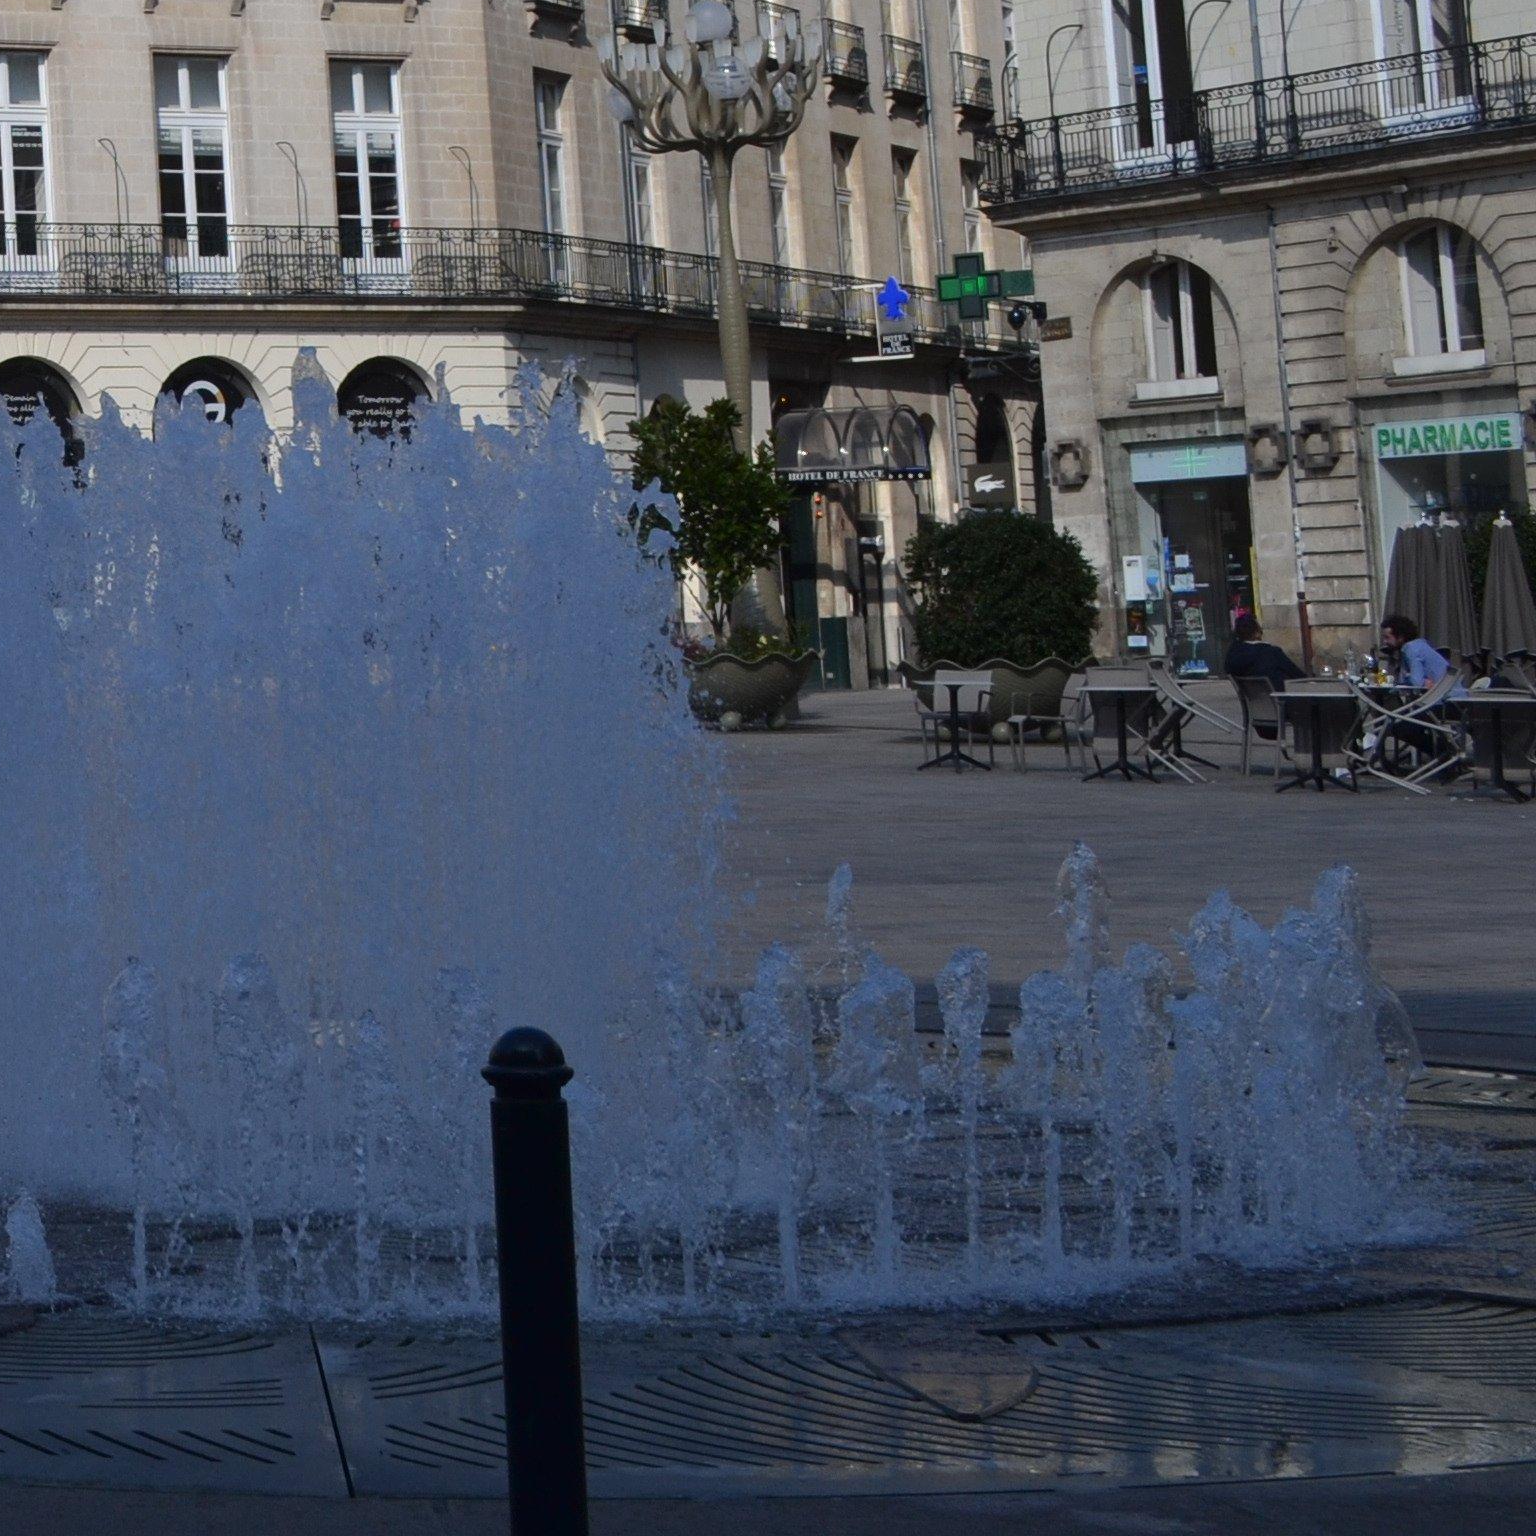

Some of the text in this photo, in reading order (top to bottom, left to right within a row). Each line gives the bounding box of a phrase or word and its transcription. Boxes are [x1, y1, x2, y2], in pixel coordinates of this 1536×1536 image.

[1377, 419, 1513, 456] PHARMACIE
[788, 469, 884, 482] HOTEL DE FRANCE
